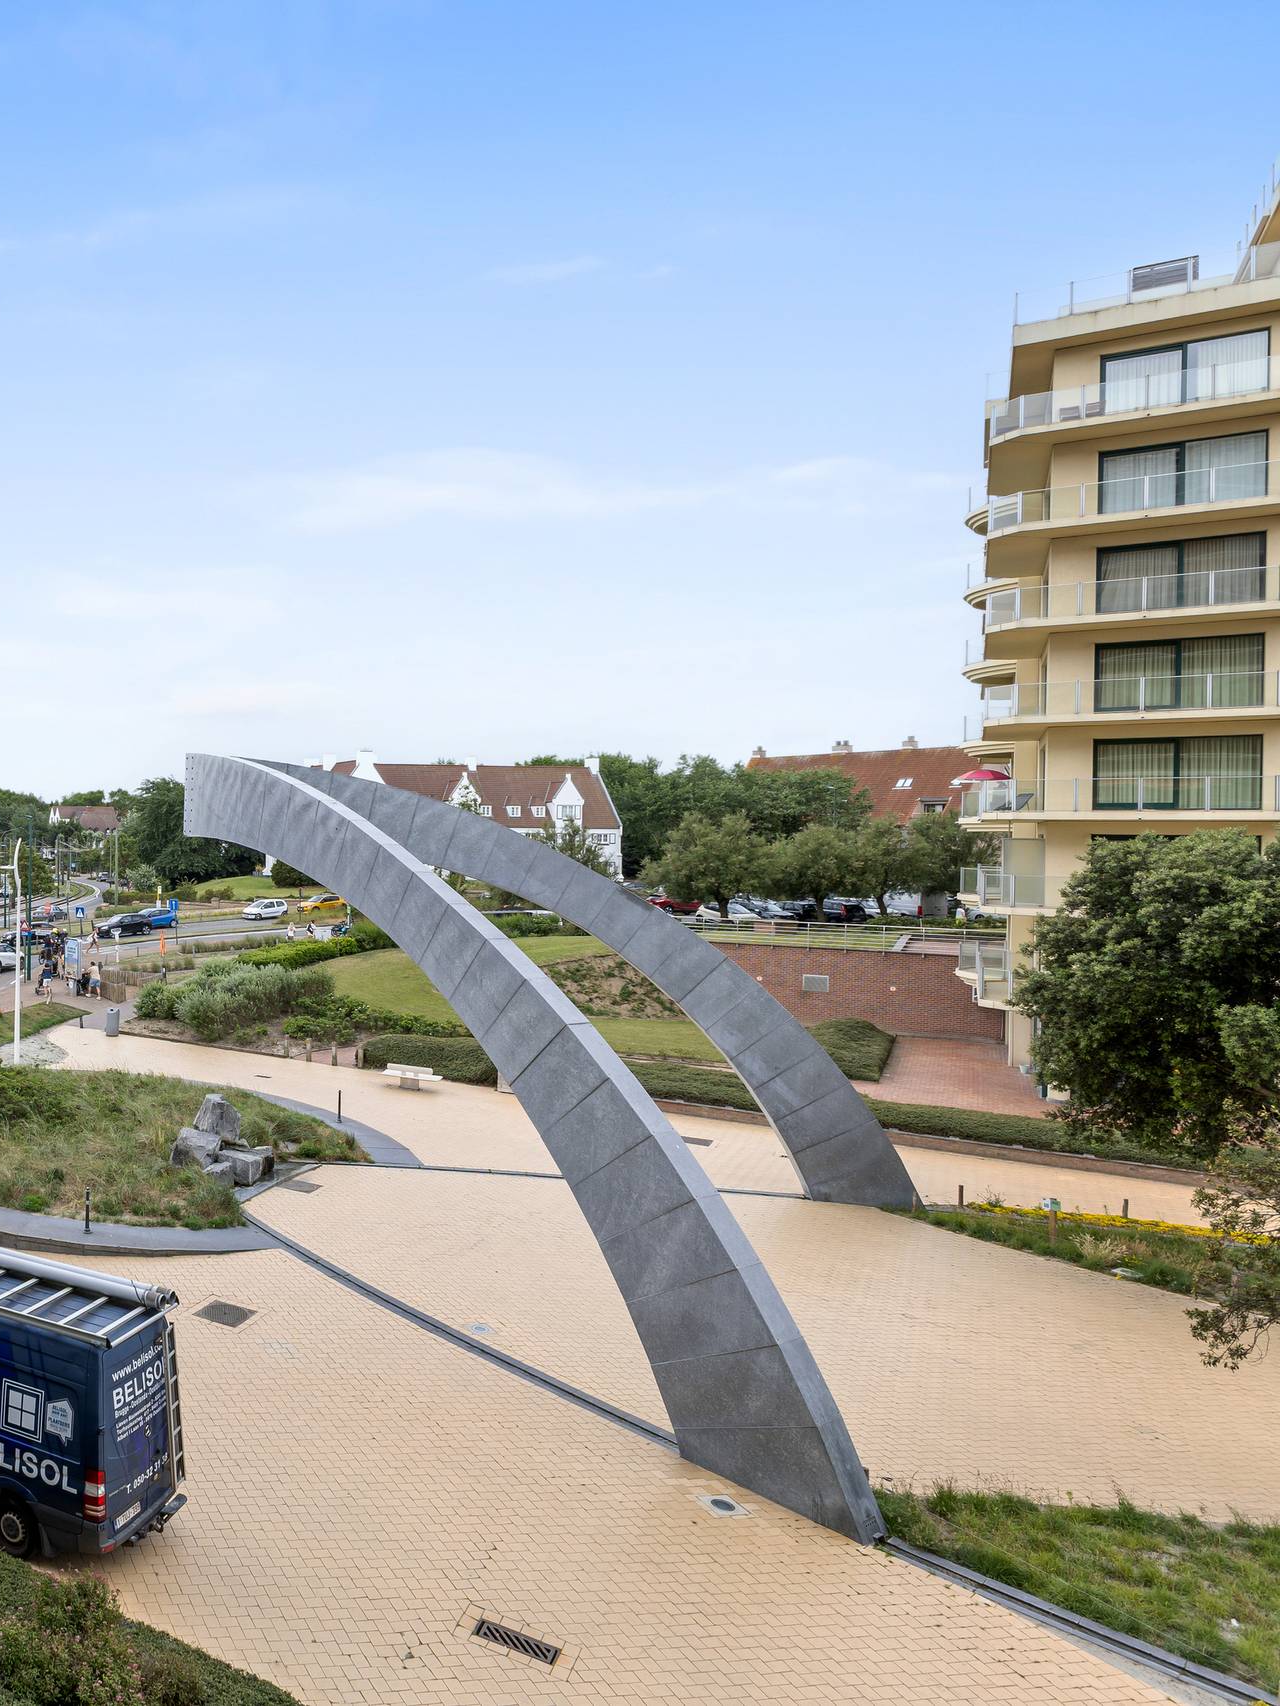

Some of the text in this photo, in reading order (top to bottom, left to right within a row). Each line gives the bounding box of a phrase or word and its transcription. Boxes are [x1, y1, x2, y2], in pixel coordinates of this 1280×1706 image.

[111, 1344, 163, 1382] www.belisol.co
[126, 1483, 132, 1494] T.
[133, 1465, 153, 1489] 050-32
